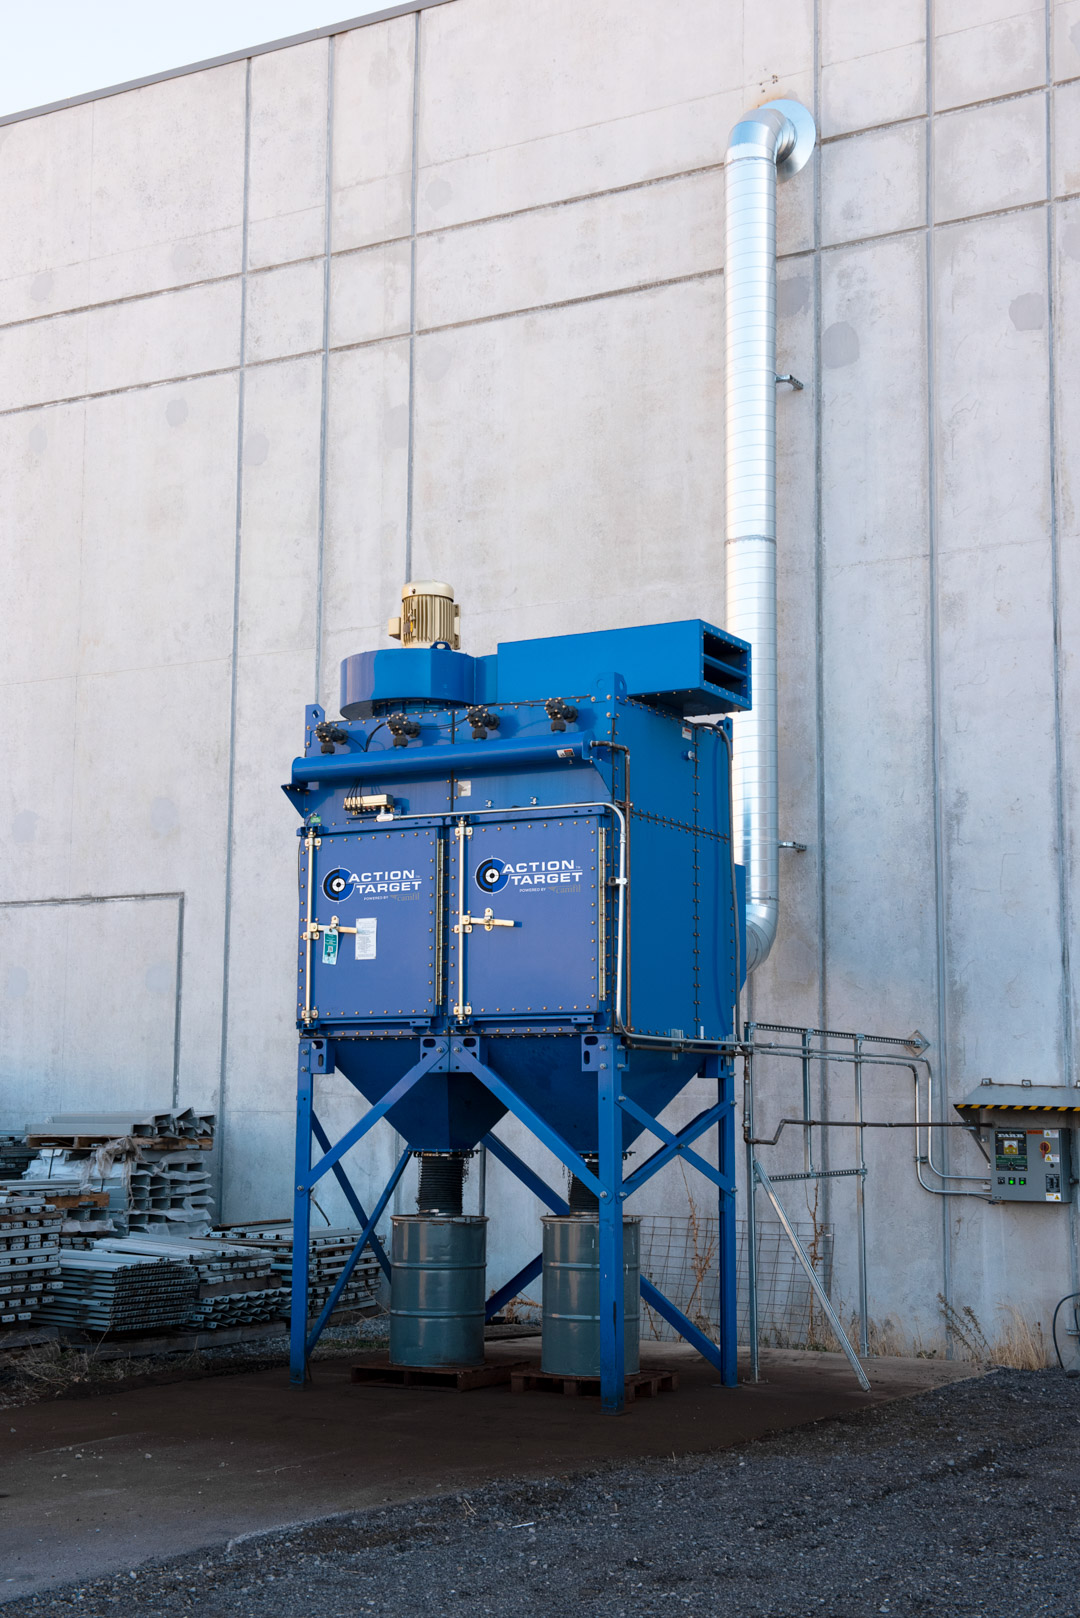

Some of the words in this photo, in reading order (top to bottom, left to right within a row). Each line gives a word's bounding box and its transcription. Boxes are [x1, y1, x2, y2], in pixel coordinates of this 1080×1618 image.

[503, 860, 574, 873] ACTION
[349, 870, 414, 882] ACTION
[511, 873, 583, 885] TARGET
[356, 882, 421, 893] TARGET
